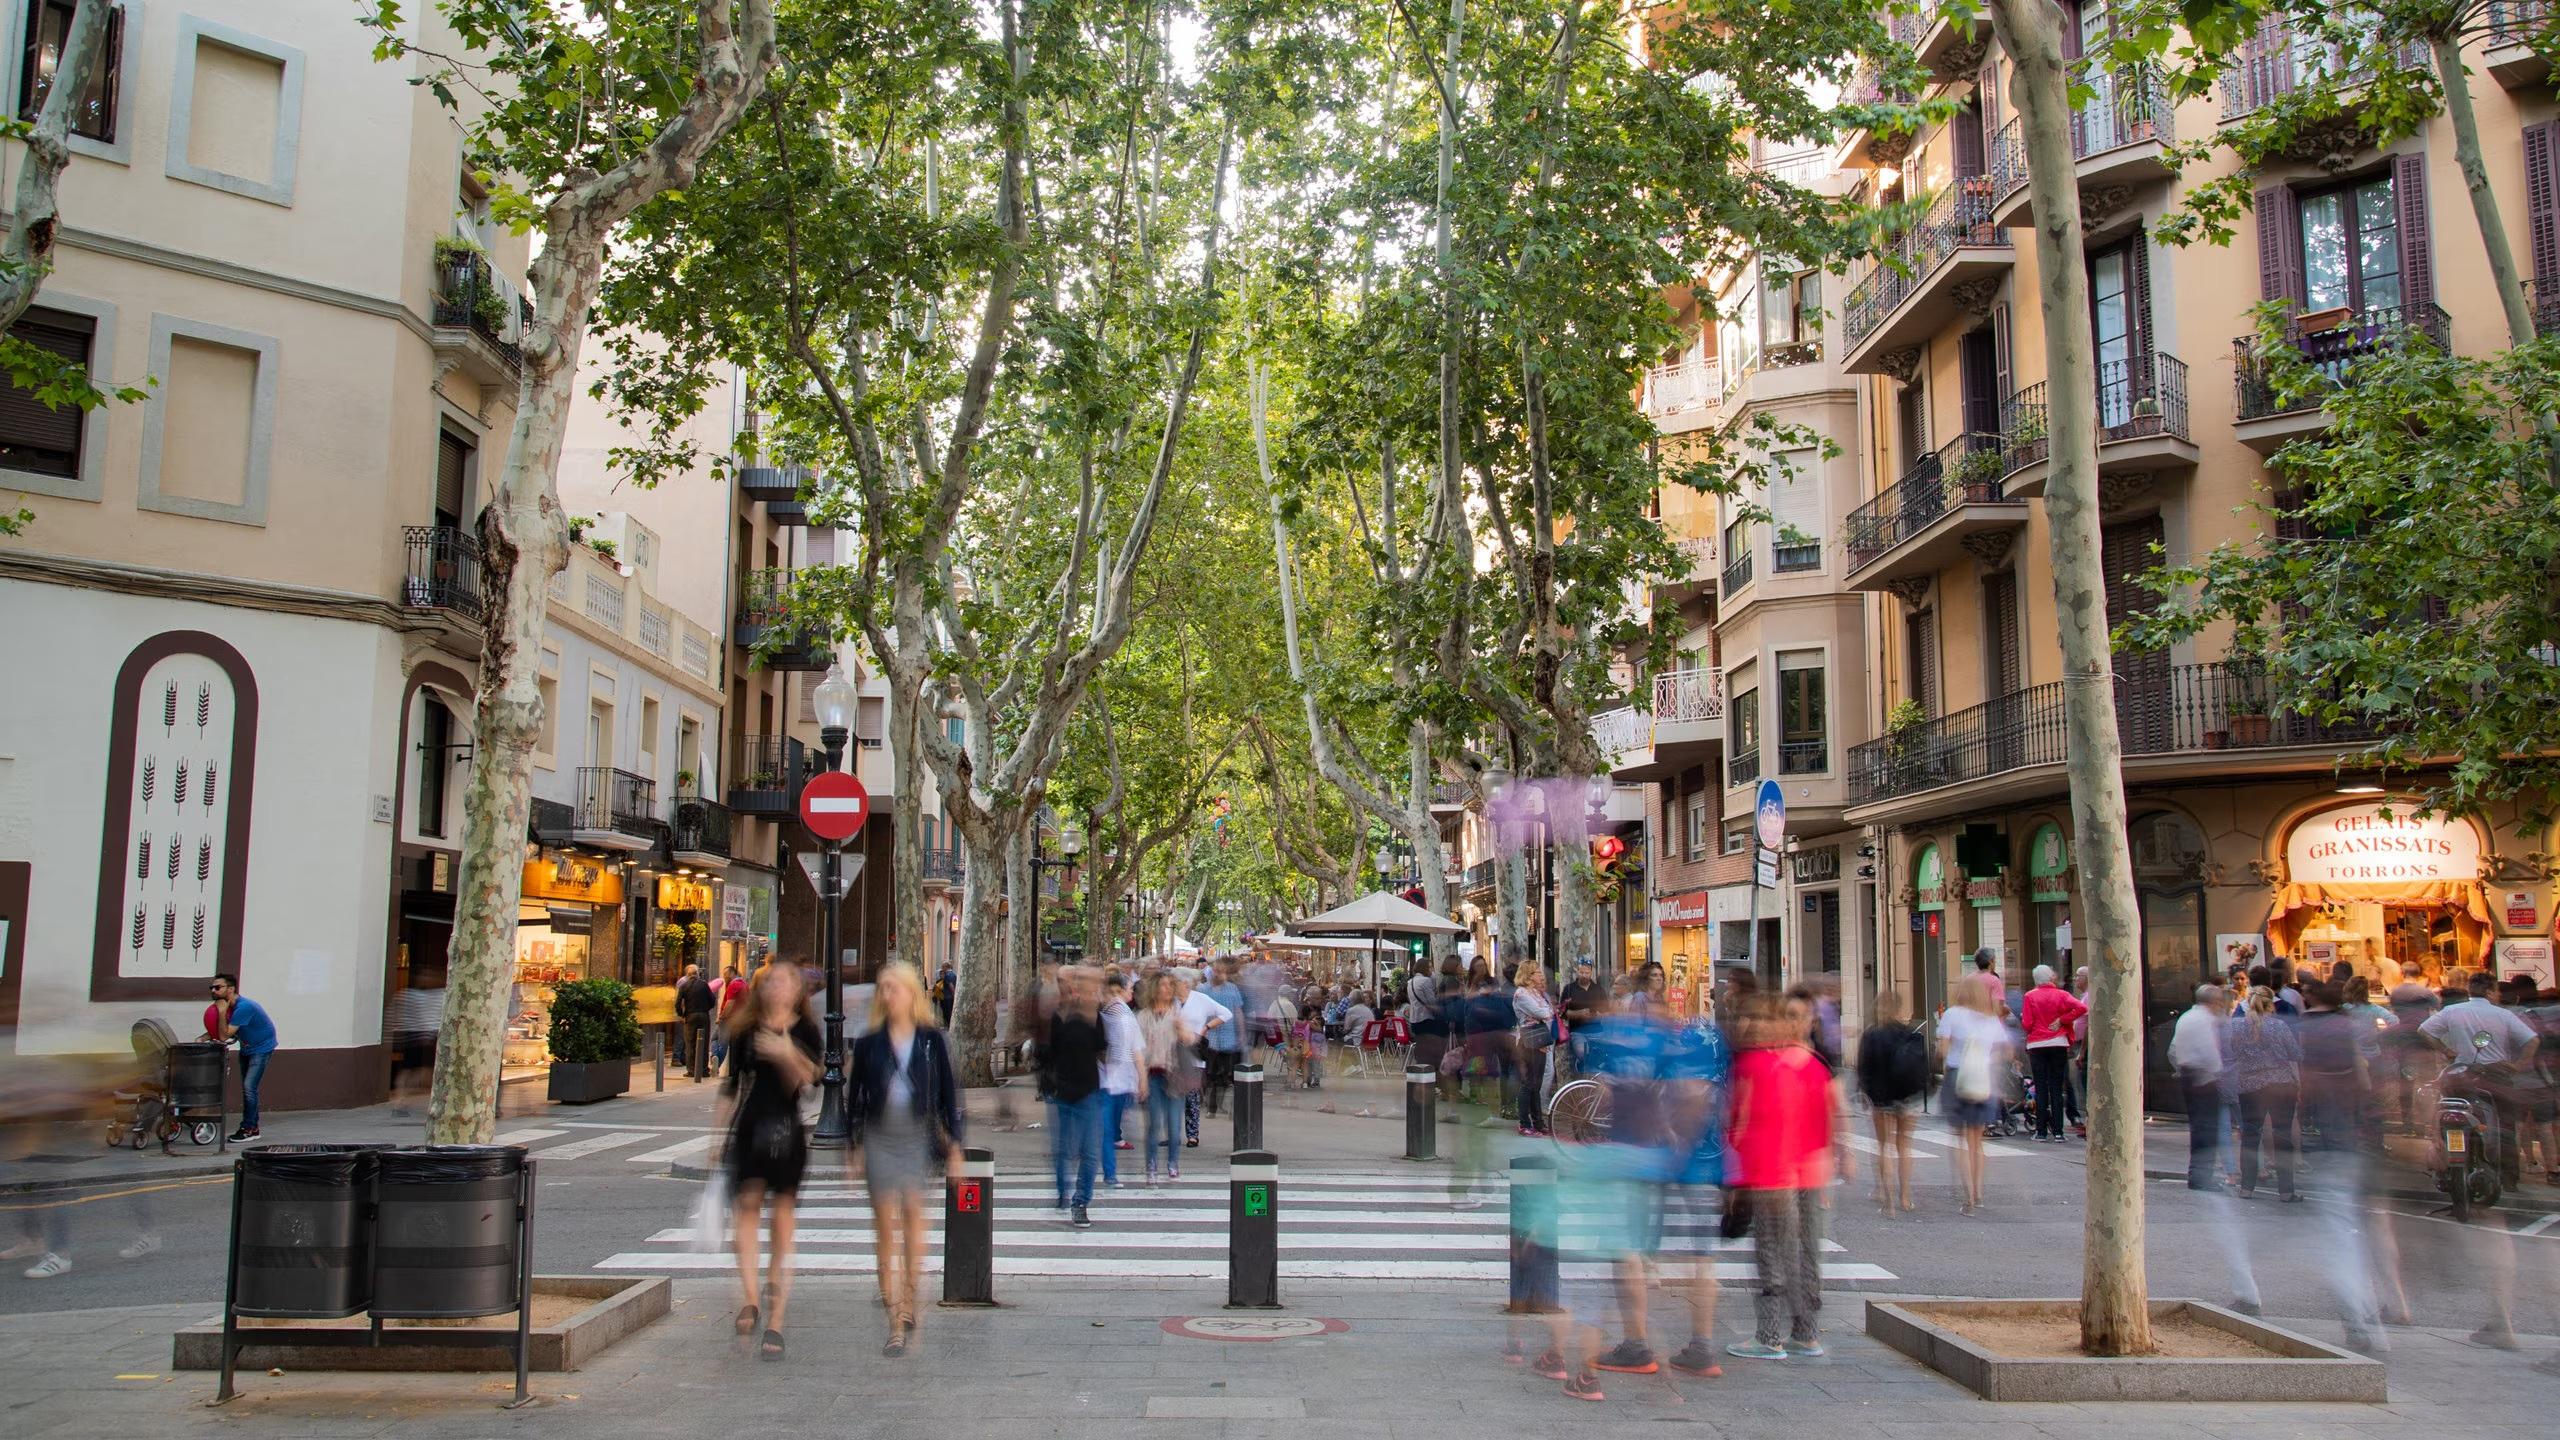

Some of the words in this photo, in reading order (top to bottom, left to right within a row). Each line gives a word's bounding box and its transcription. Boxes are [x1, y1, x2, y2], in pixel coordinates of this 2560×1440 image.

[2335, 814, 2423, 833] GELATS
[2309, 837, 2452, 860] GRANISSATS
[2327, 864, 2438, 878] TORRONS
